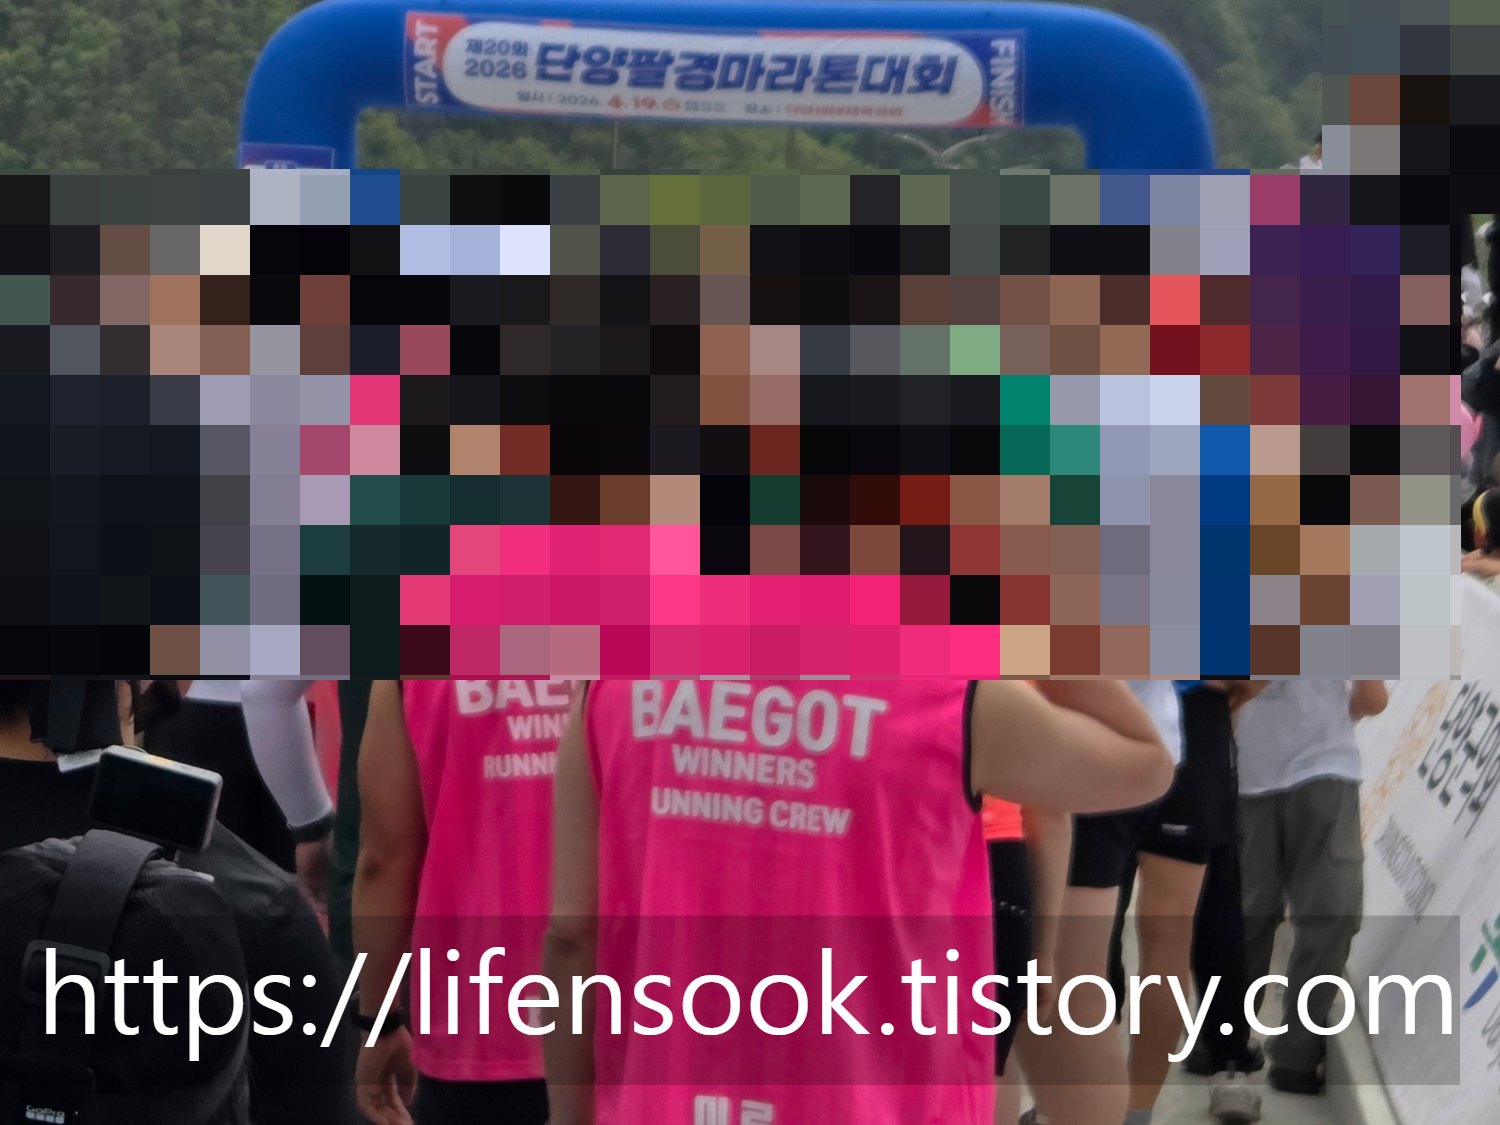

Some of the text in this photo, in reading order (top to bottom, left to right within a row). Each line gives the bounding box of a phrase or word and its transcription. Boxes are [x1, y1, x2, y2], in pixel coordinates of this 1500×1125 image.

[414, 19, 439, 105] START
[464, 58, 528, 80] 2026
[465, 38, 529, 57] 제20회
[534, 41, 959, 96] 단양팔경마라톤대회
[455, 679, 577, 715] BAE
[631, 679, 888, 758] BAEGOT
[506, 713, 571, 741] WIN
[671, 744, 817, 790] WINNERS
[651, 786, 852, 836] UNNING CREW
